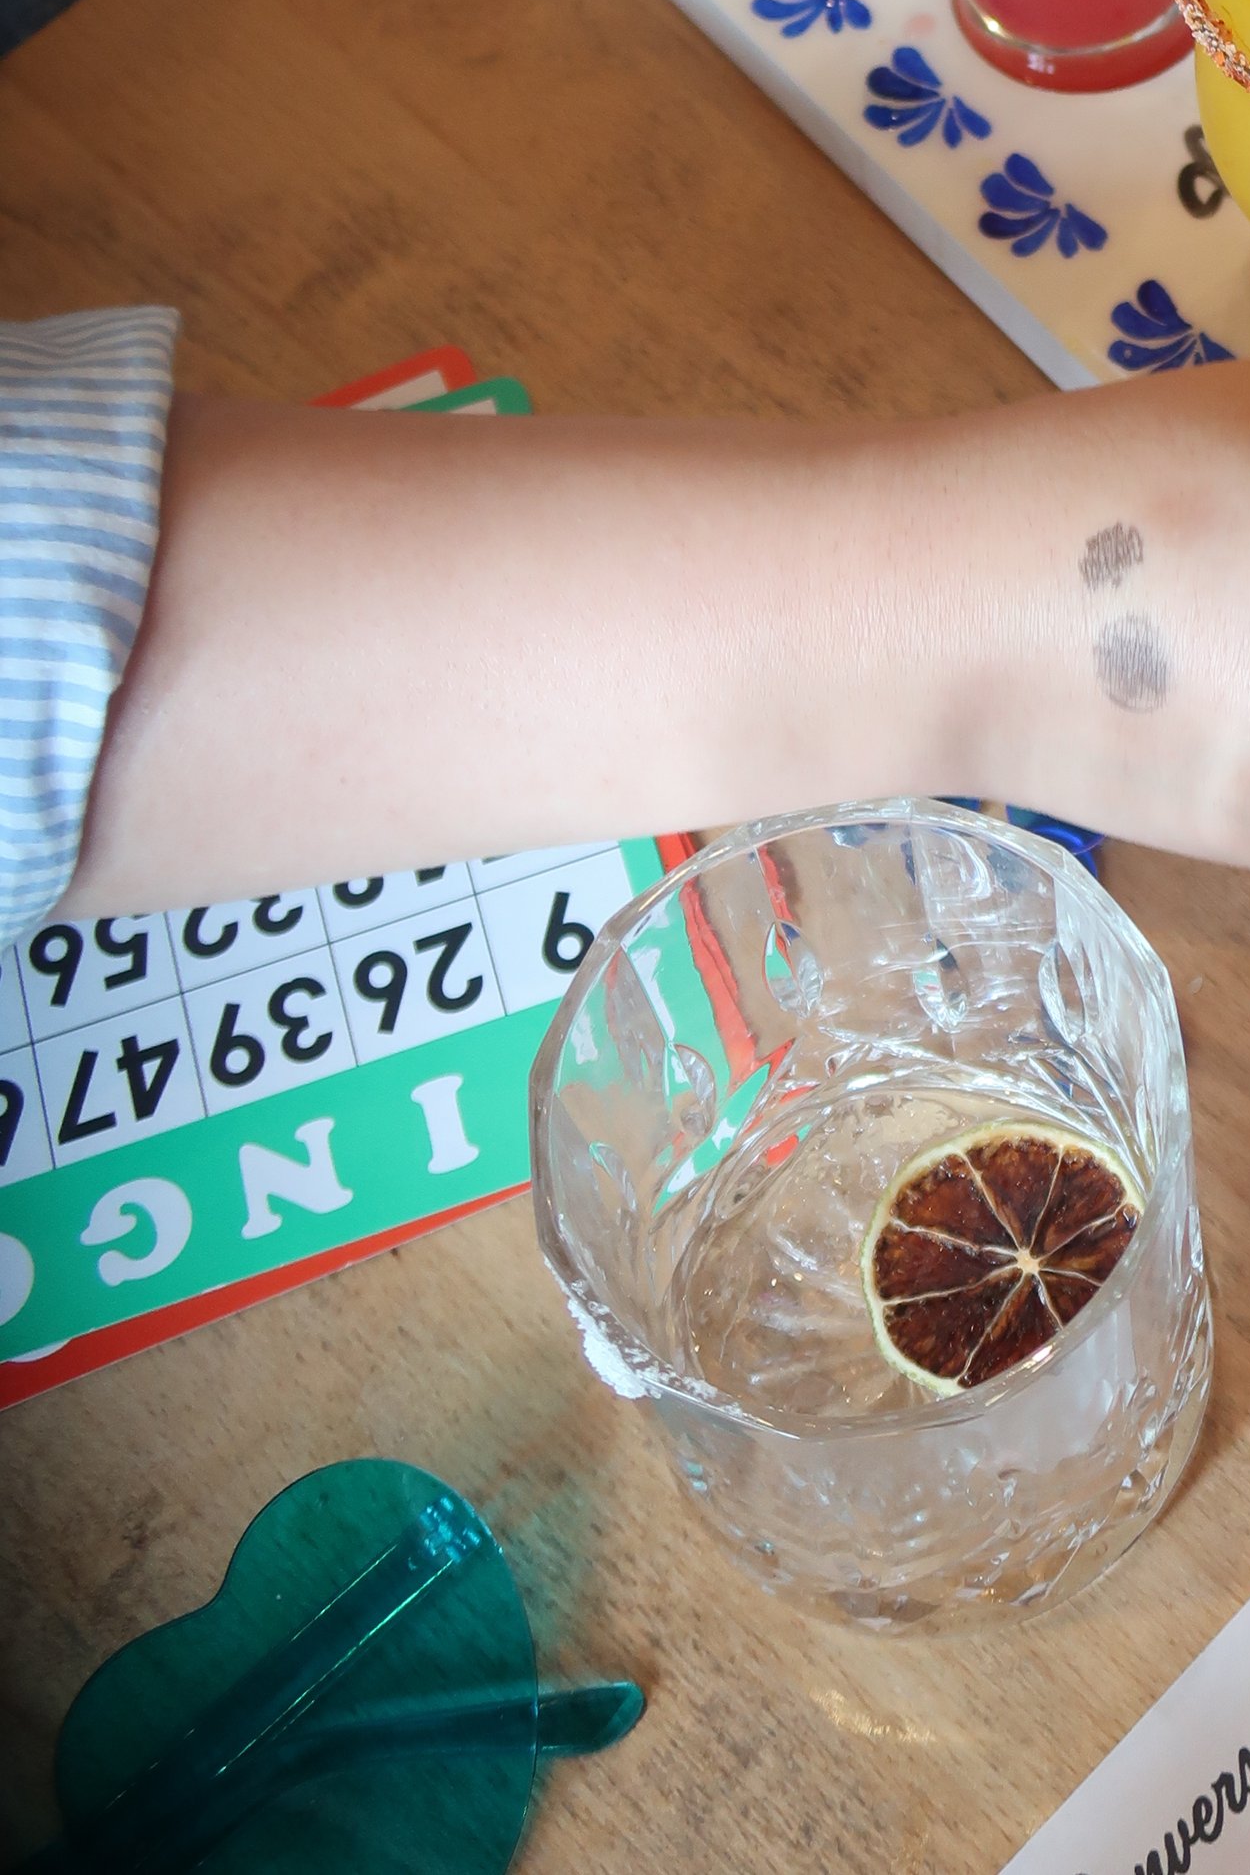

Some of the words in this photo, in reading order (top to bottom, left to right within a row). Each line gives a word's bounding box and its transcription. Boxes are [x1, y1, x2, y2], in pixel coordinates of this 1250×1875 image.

[29, 914, 150, 1006] 56
[354, 922, 485, 1034] 26
[209, 977, 334, 1088] 39
[57, 1035, 180, 1146] 47
